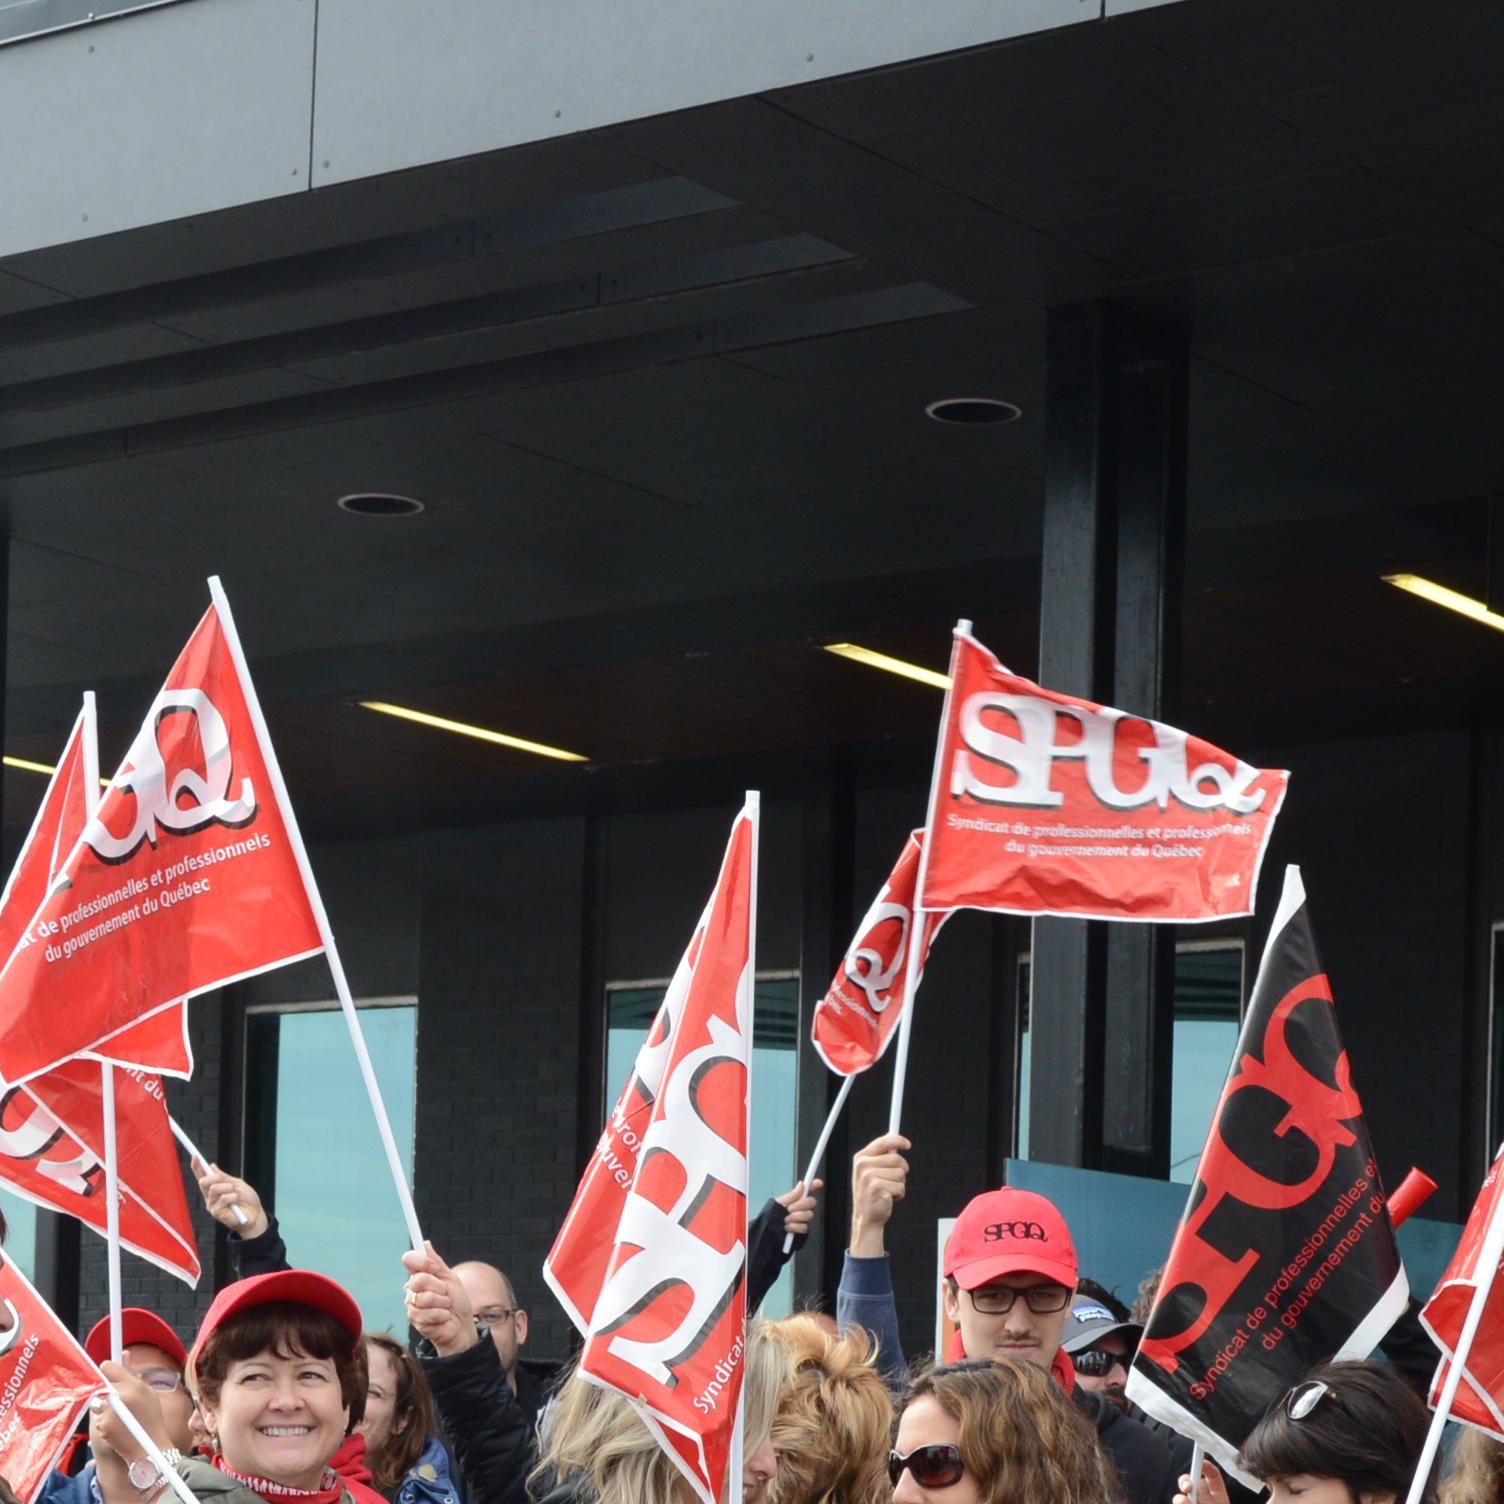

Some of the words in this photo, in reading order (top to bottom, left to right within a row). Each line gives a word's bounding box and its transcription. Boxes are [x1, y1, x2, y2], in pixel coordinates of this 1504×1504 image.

[946, 812, 1009, 834] Syndicat
[1010, 822, 1031, 836] de
[1032, 821, 1145, 841] professionnelles
[1147, 826, 1161, 839] et
[1163, 822, 1252, 841] professionnels
[1004, 839, 1025, 853] du
[1026, 843, 1129, 858] gouvernement
[1131, 844, 1150, 857] du
[1152, 843, 1204, 858] Québec
[37, 920, 59, 938] de
[59, 873, 149, 933] professionnelles
[150, 870, 163, 887] et
[165, 831, 271, 884] professionnels
[45, 943, 62, 963] du
[63, 904, 141, 959] gouvernement
[142, 896, 159, 916] du
[160, 876, 211, 909] Québec
[984, 1220, 1048, 1243] SPGQ
[1189, 1329, 1250, 1400] Syndicat
[1245, 1305, 1268, 1331] de
[1264, 1177, 1369, 1309] professionnelles
[1262, 1327, 1284, 1351] du
[1281, 1211, 1374, 1329] gouvernement
[693, 1335, 744, 1414] Syndicat
